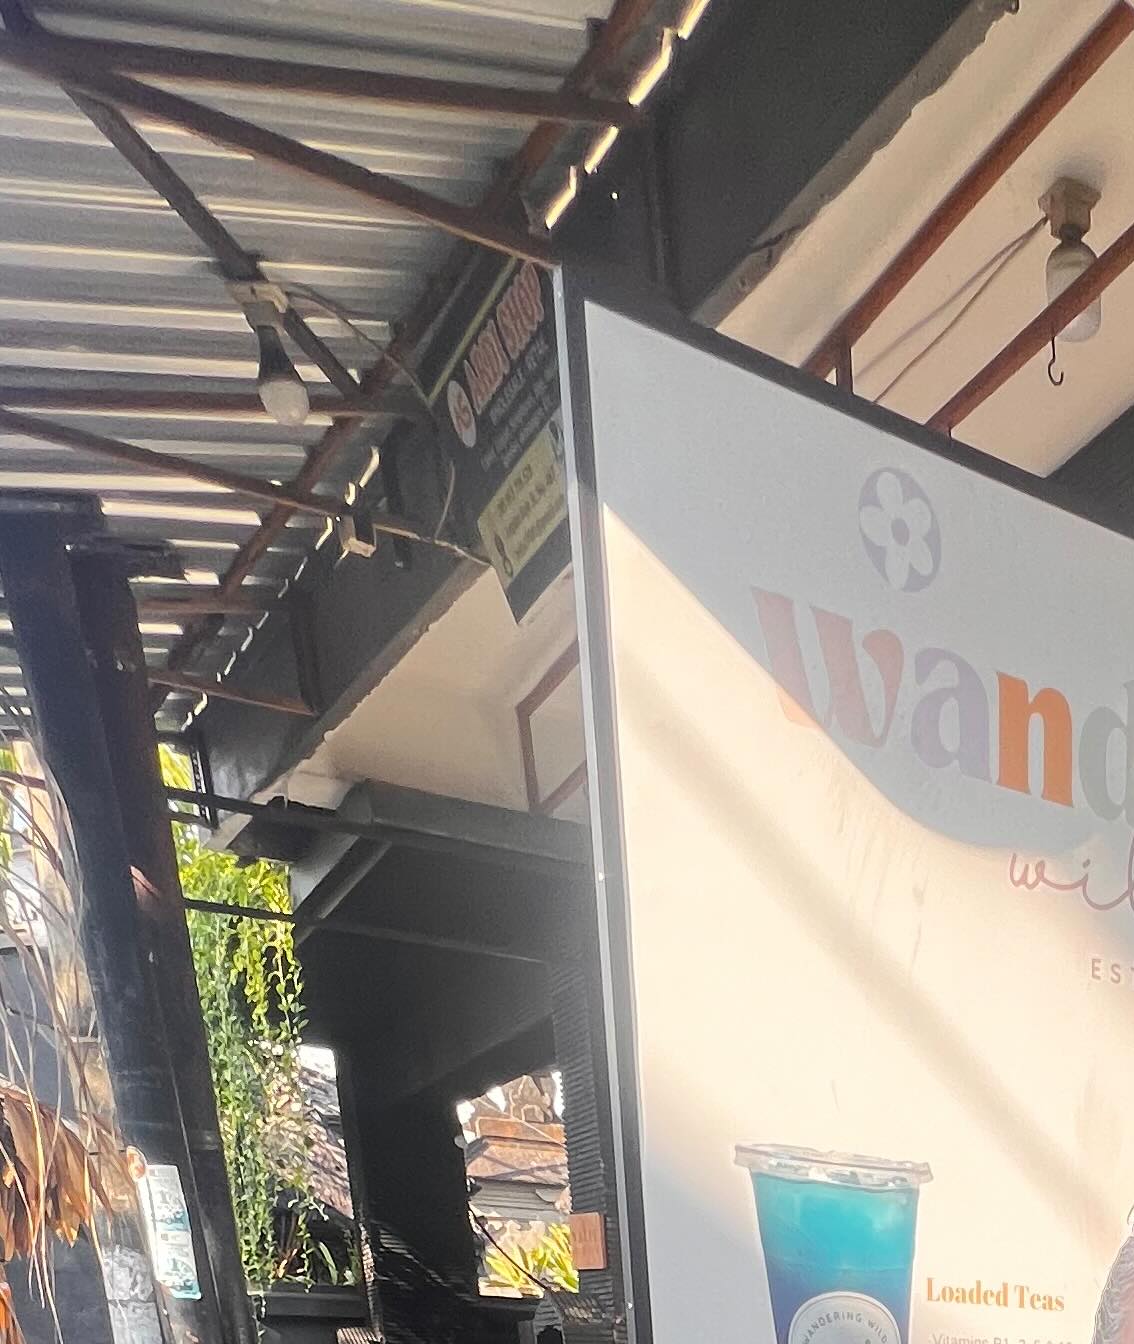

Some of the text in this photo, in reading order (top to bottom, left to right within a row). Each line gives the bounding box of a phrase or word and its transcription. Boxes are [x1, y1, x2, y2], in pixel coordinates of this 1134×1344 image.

[926, 1277, 1065, 1311] Loaded Teas
[867, 1318, 889, 1344] WILD
